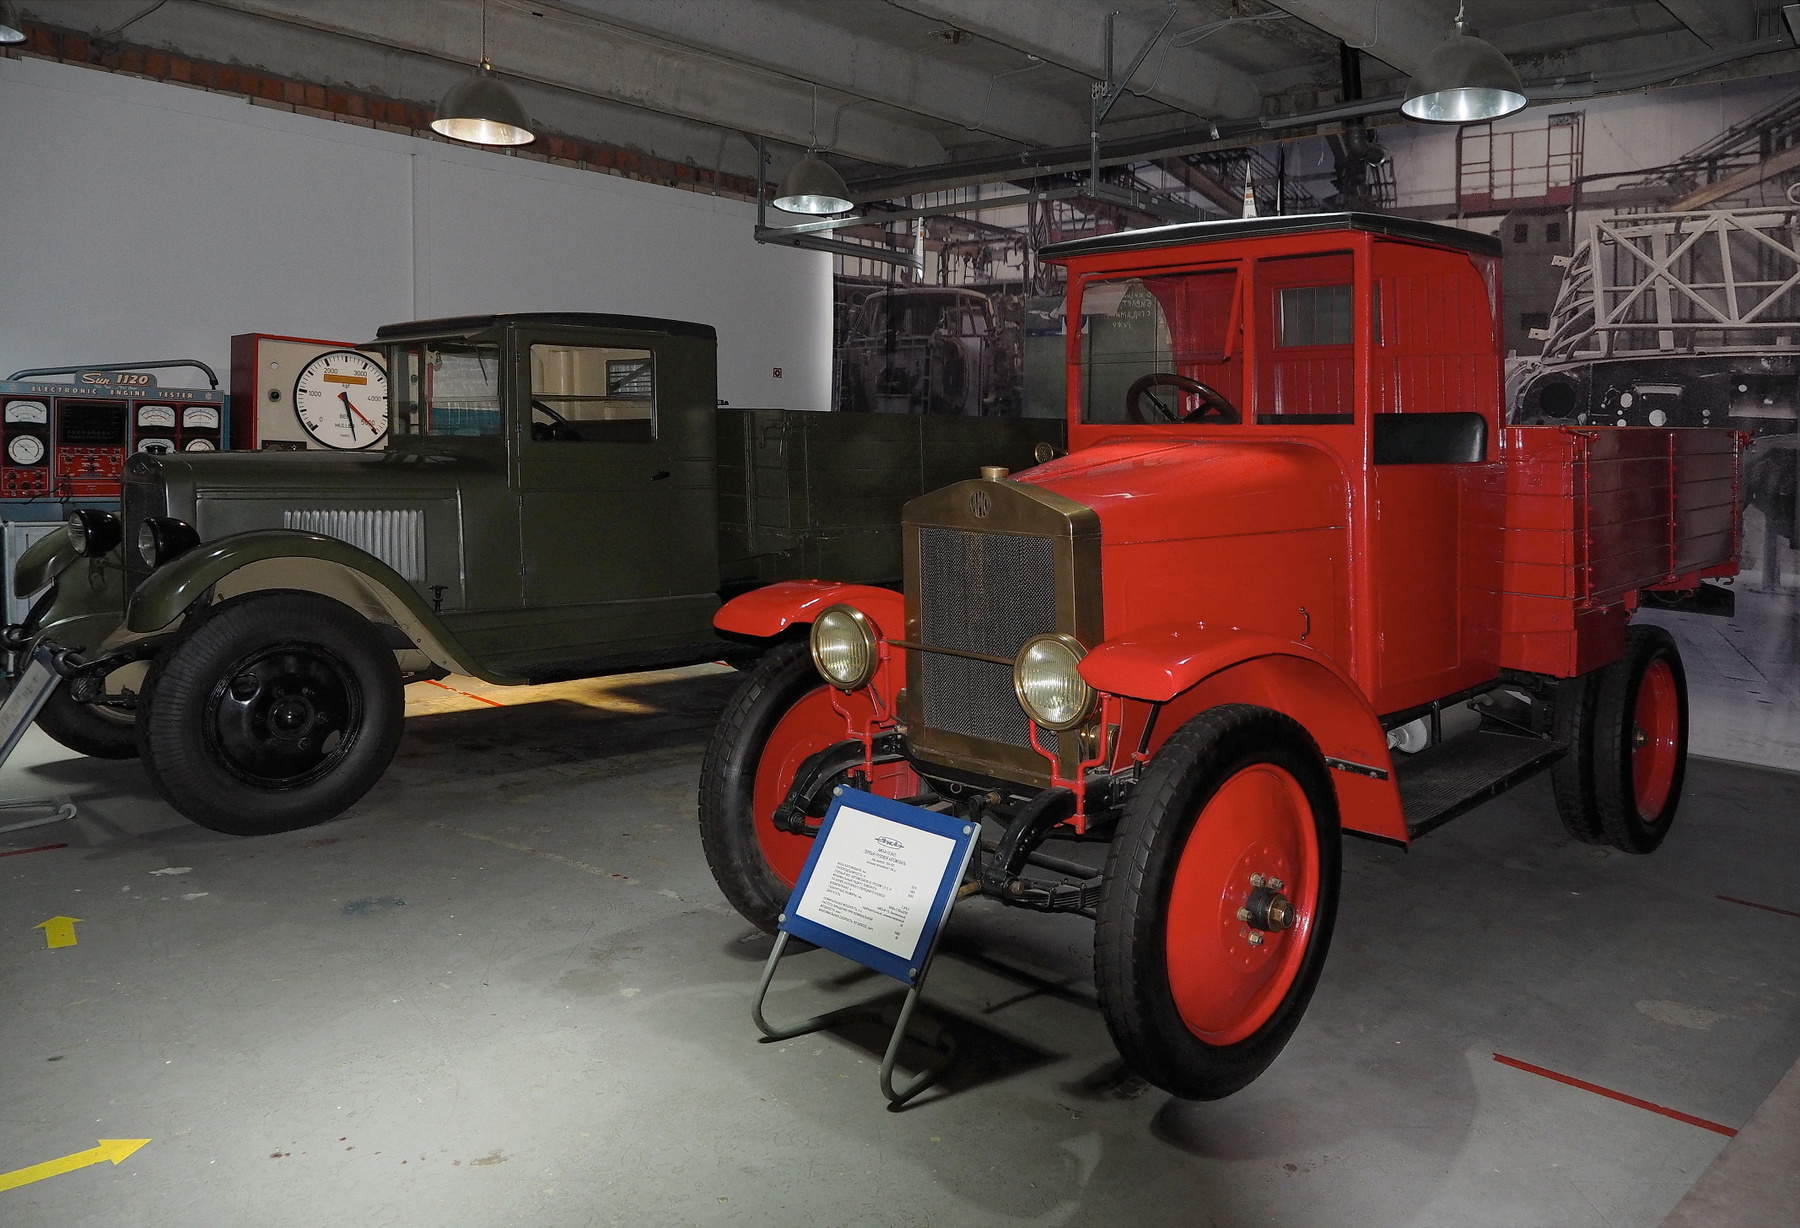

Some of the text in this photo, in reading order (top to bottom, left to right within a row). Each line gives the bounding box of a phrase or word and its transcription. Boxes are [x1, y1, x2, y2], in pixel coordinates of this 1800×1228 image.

[82, 373, 149, 384] Sun 1120
[32, 386, 98, 394] ELECTRONIC
